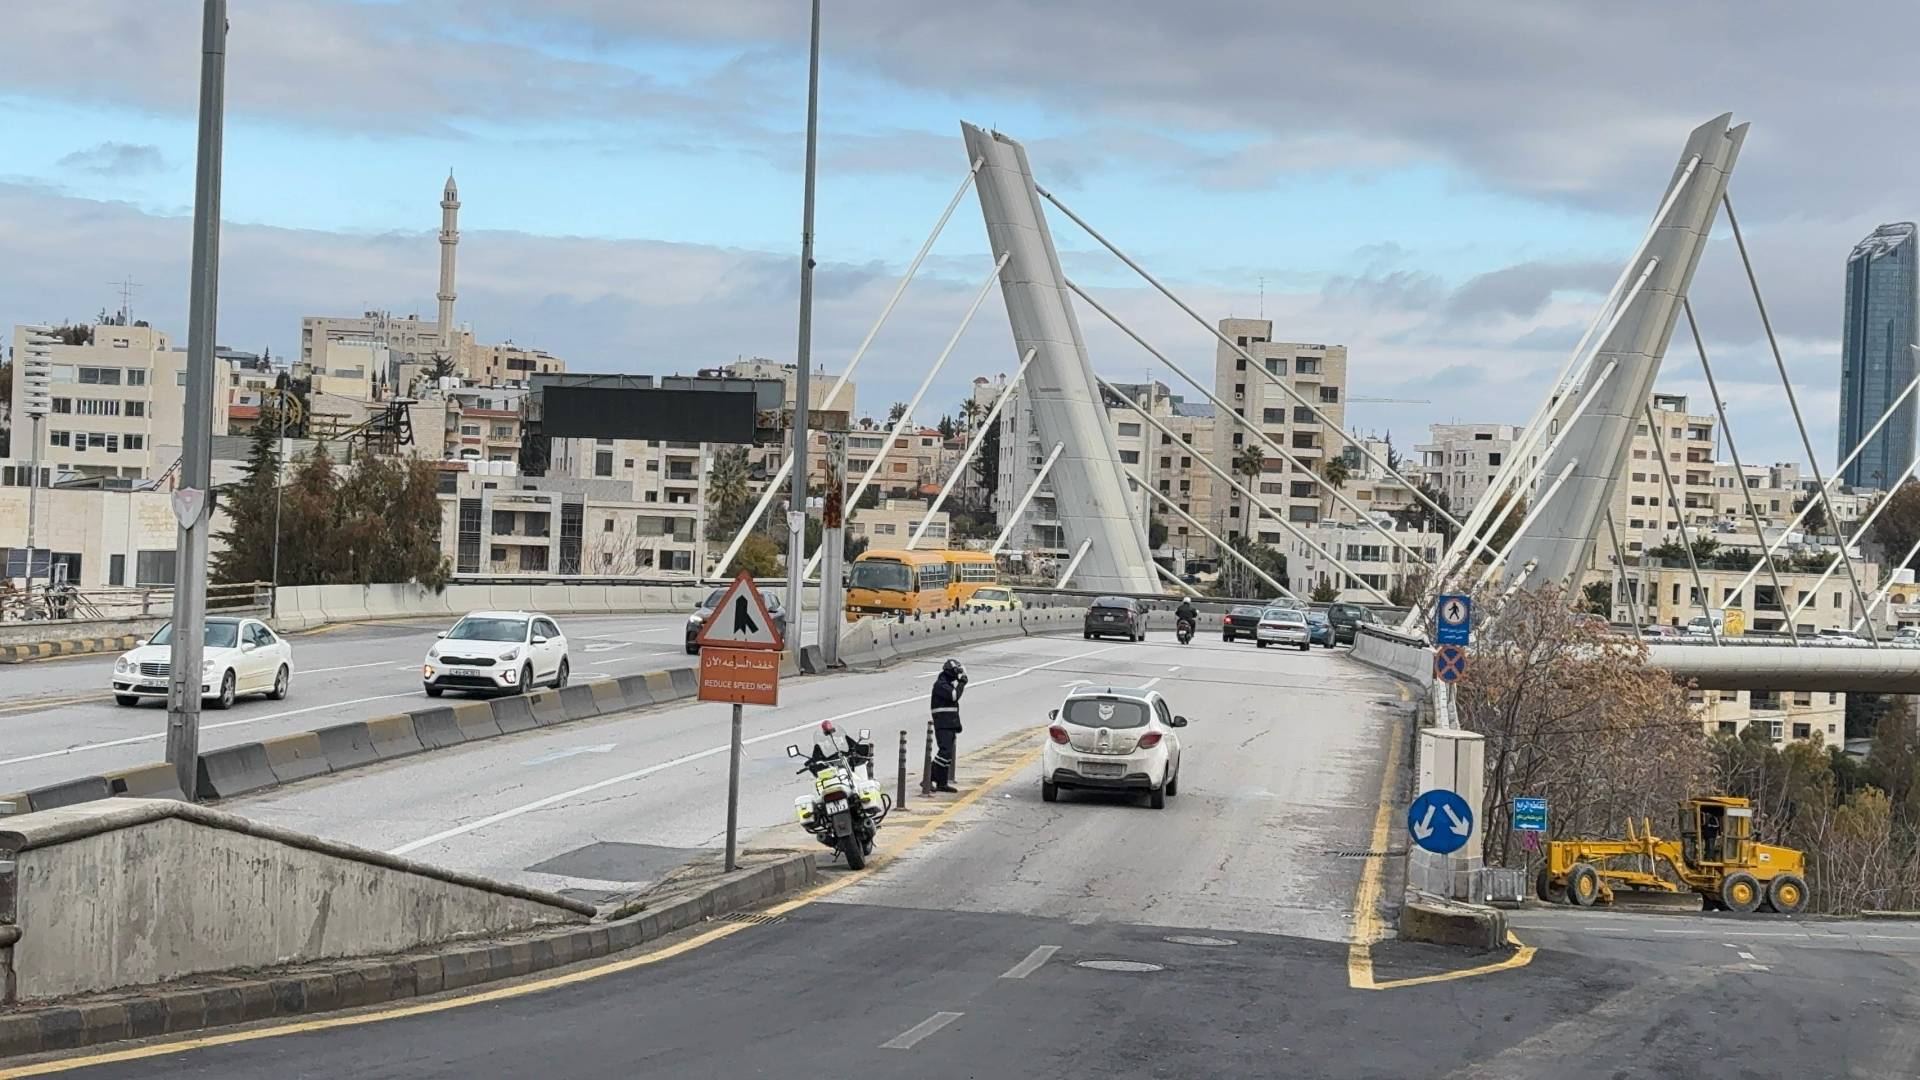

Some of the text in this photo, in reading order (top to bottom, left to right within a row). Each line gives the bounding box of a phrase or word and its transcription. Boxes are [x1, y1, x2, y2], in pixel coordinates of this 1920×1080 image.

[752, 660, 775, 670] خفف
[704, 680, 773, 691] REDUCE SPEED NOW
